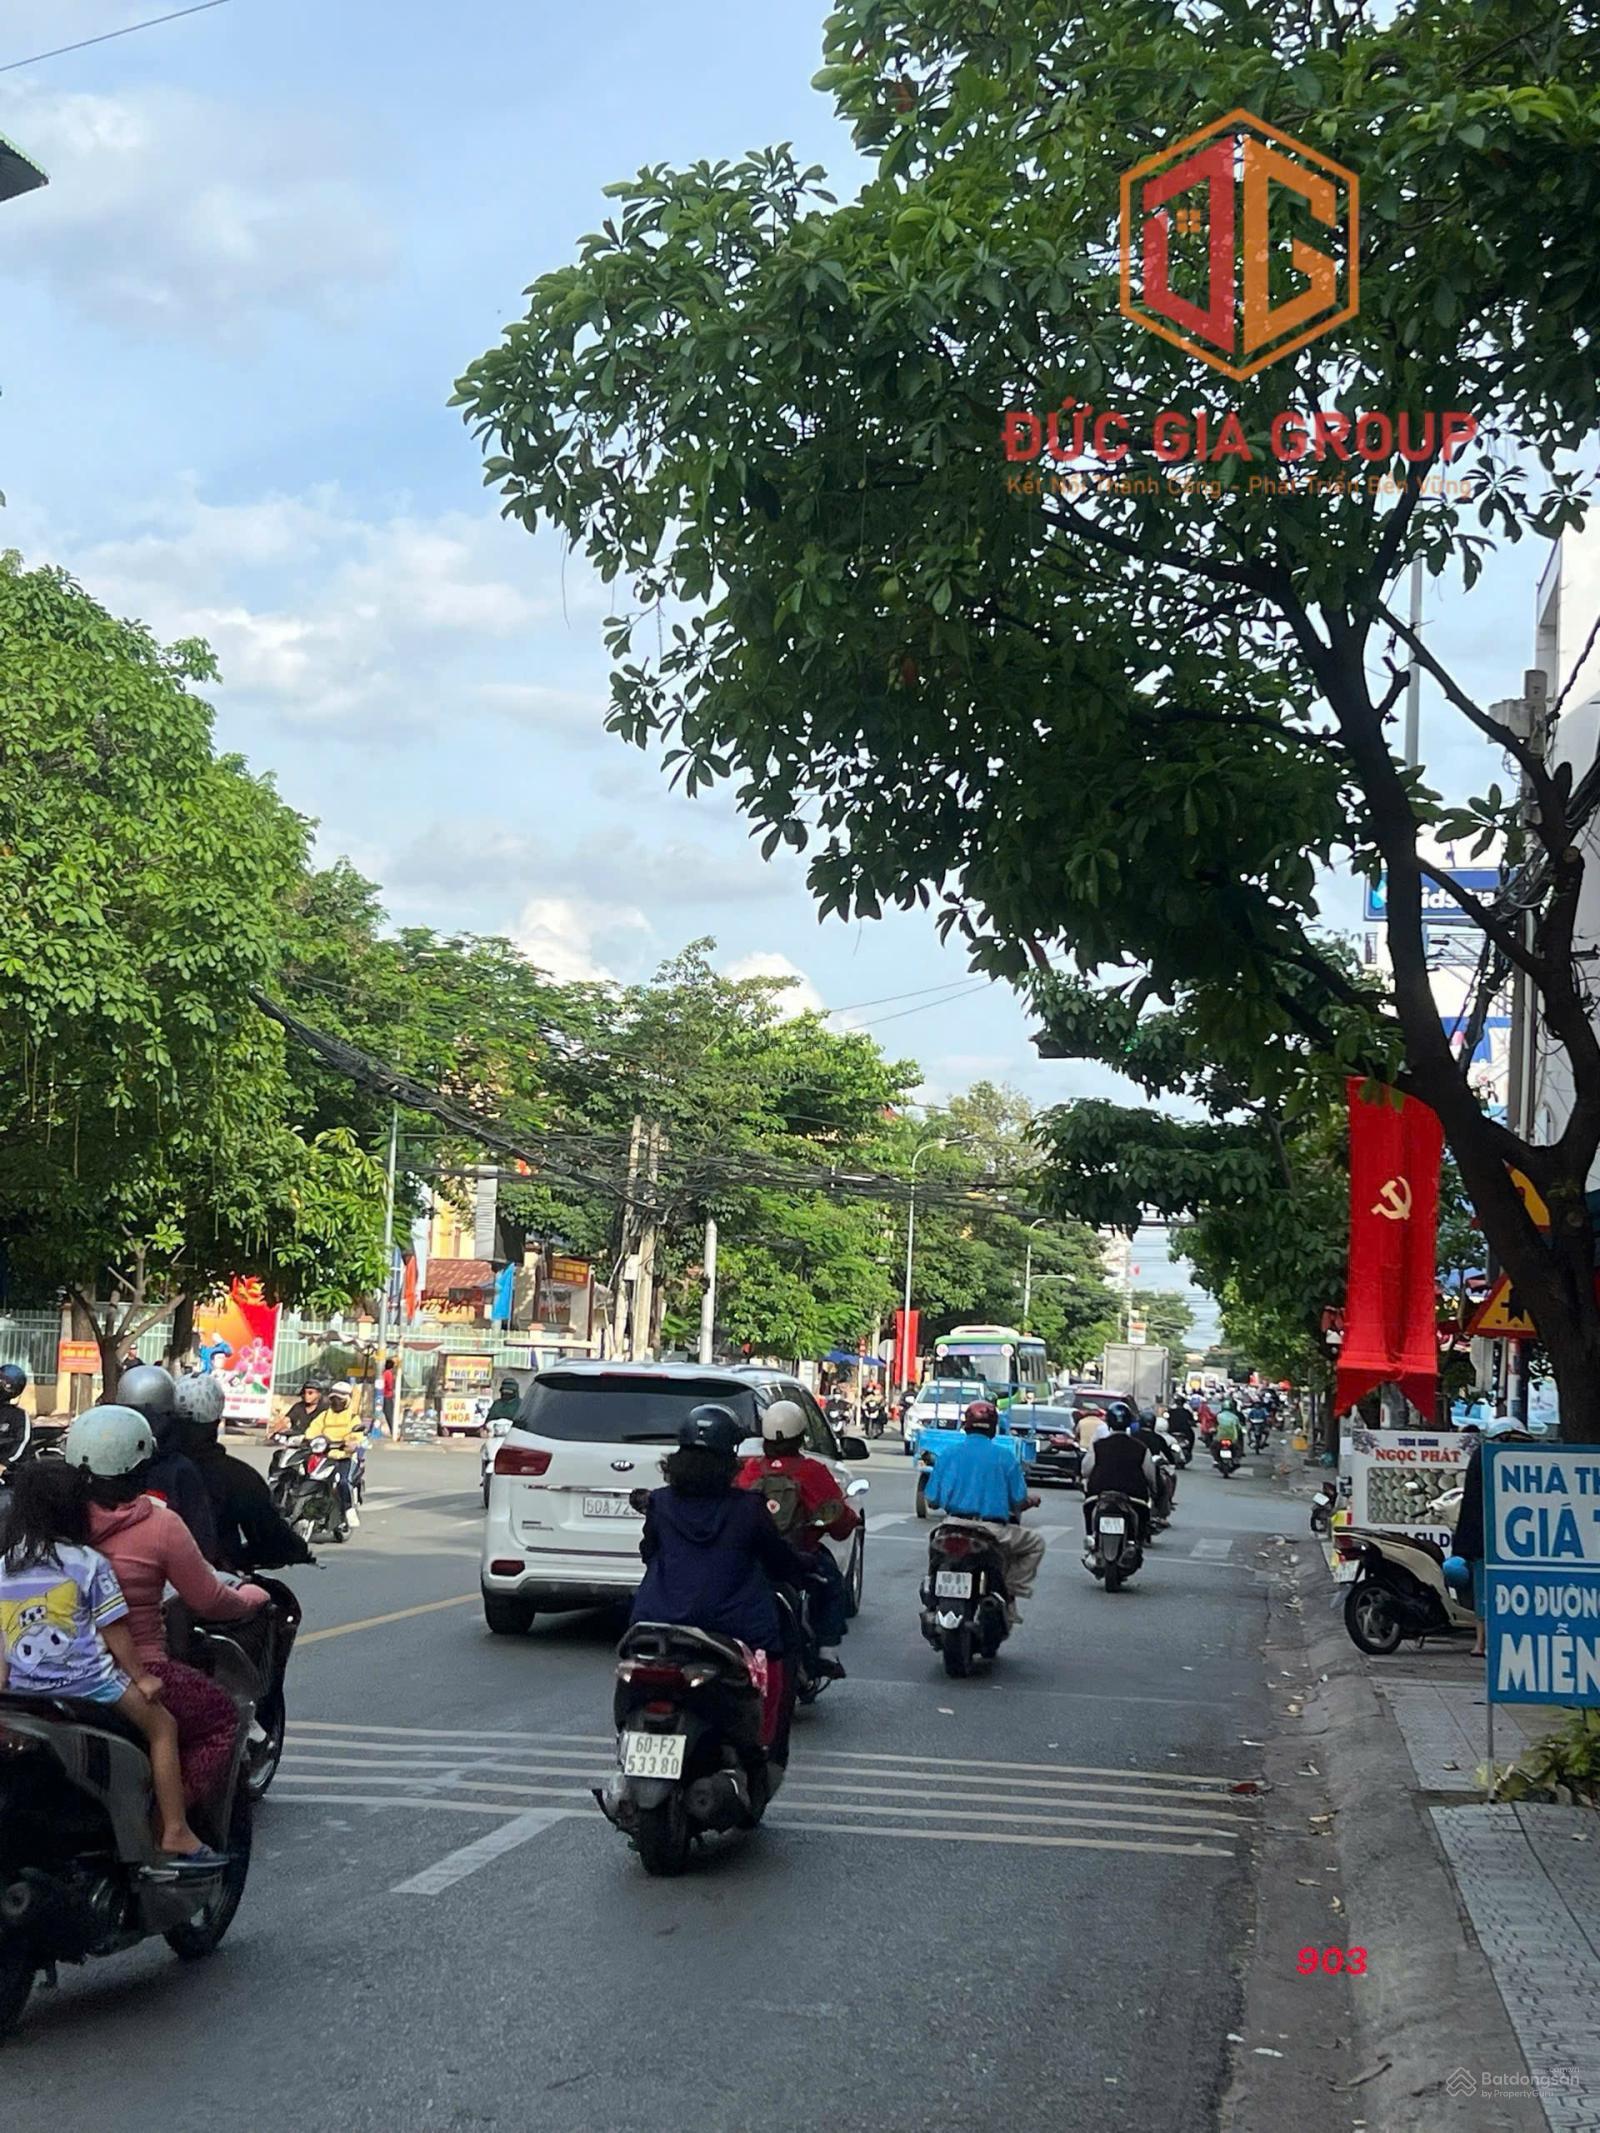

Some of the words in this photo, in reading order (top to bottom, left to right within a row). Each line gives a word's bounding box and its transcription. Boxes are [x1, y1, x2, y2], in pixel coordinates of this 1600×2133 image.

[1375, 1448, 1417, 1464] NGỌC
[1421, 1447, 1462, 1463] PHÁT
[1500, 1462, 1569, 1495] NHÀ
[1504, 1502, 1585, 1559] GIÁ
[1534, 1582, 1600, 1619] ĐƯỜN
[1497, 1622, 1600, 1695] MIỄN
[635, 1735, 677, 1756] 60-F2
[626, 1755, 680, 1776] 533.80
